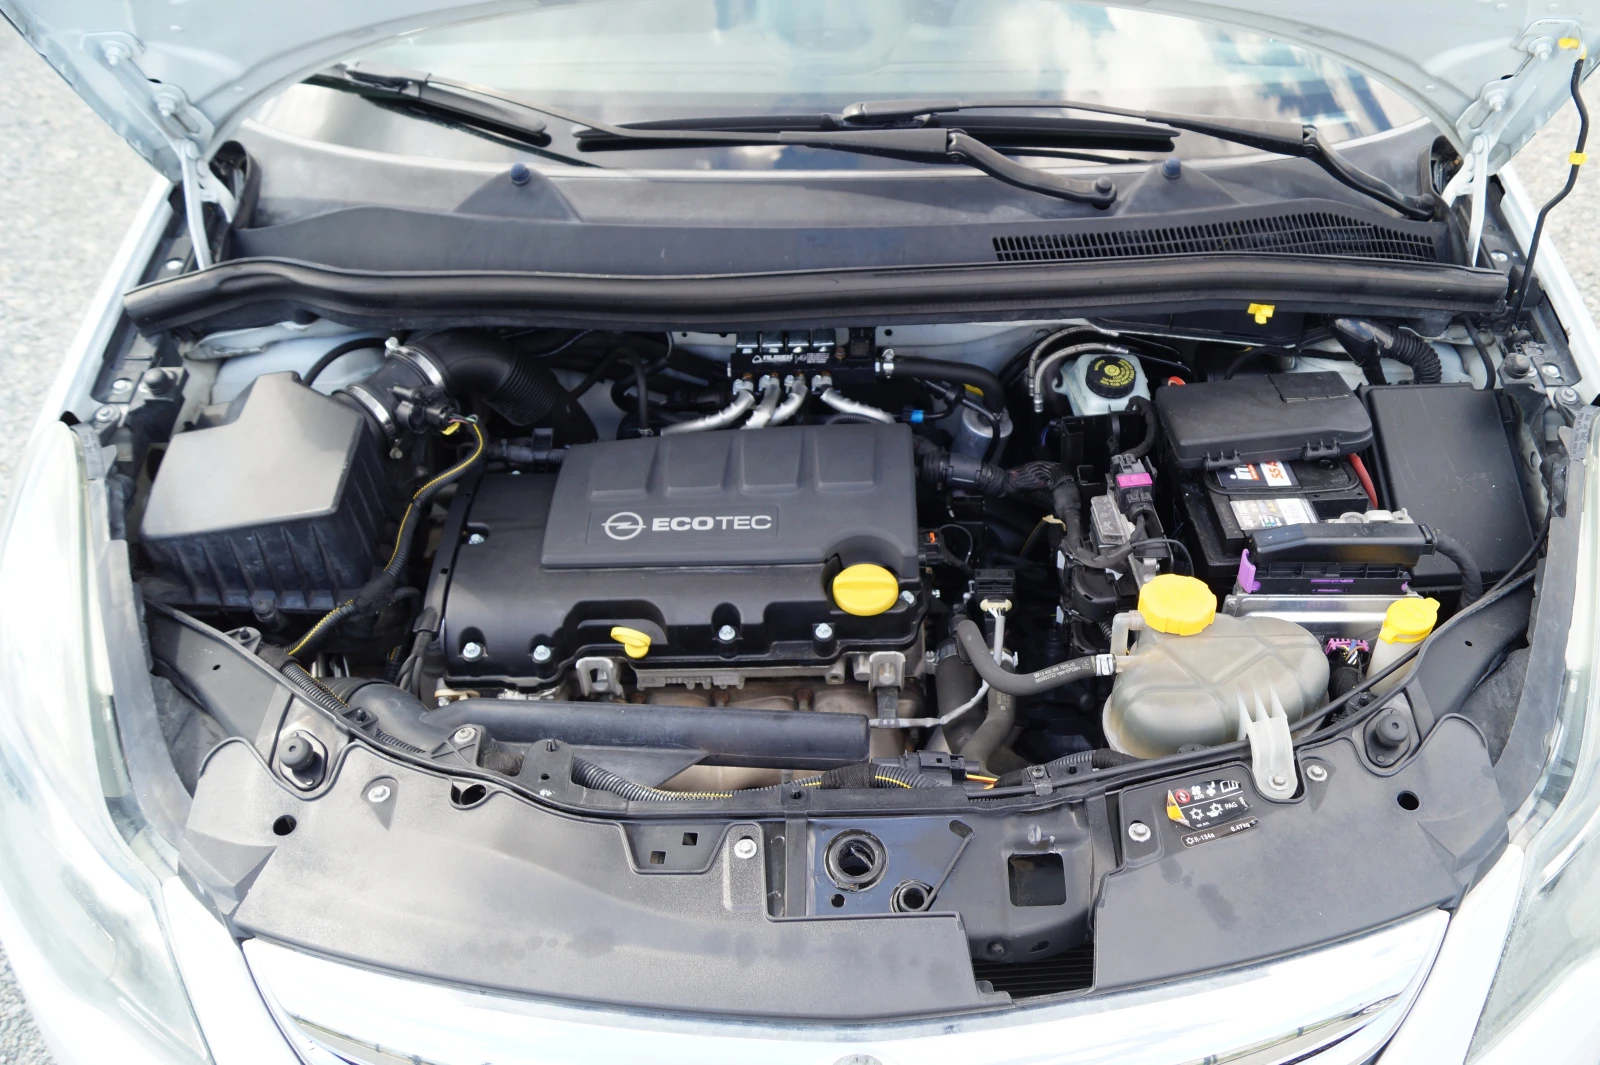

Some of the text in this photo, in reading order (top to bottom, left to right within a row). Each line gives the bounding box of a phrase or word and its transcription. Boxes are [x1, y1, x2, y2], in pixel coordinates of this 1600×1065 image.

[652, 515, 772, 531] ECOTEC
[1224, 802, 1238, 810] PAG
[1194, 832, 1215, 843] R-134a
